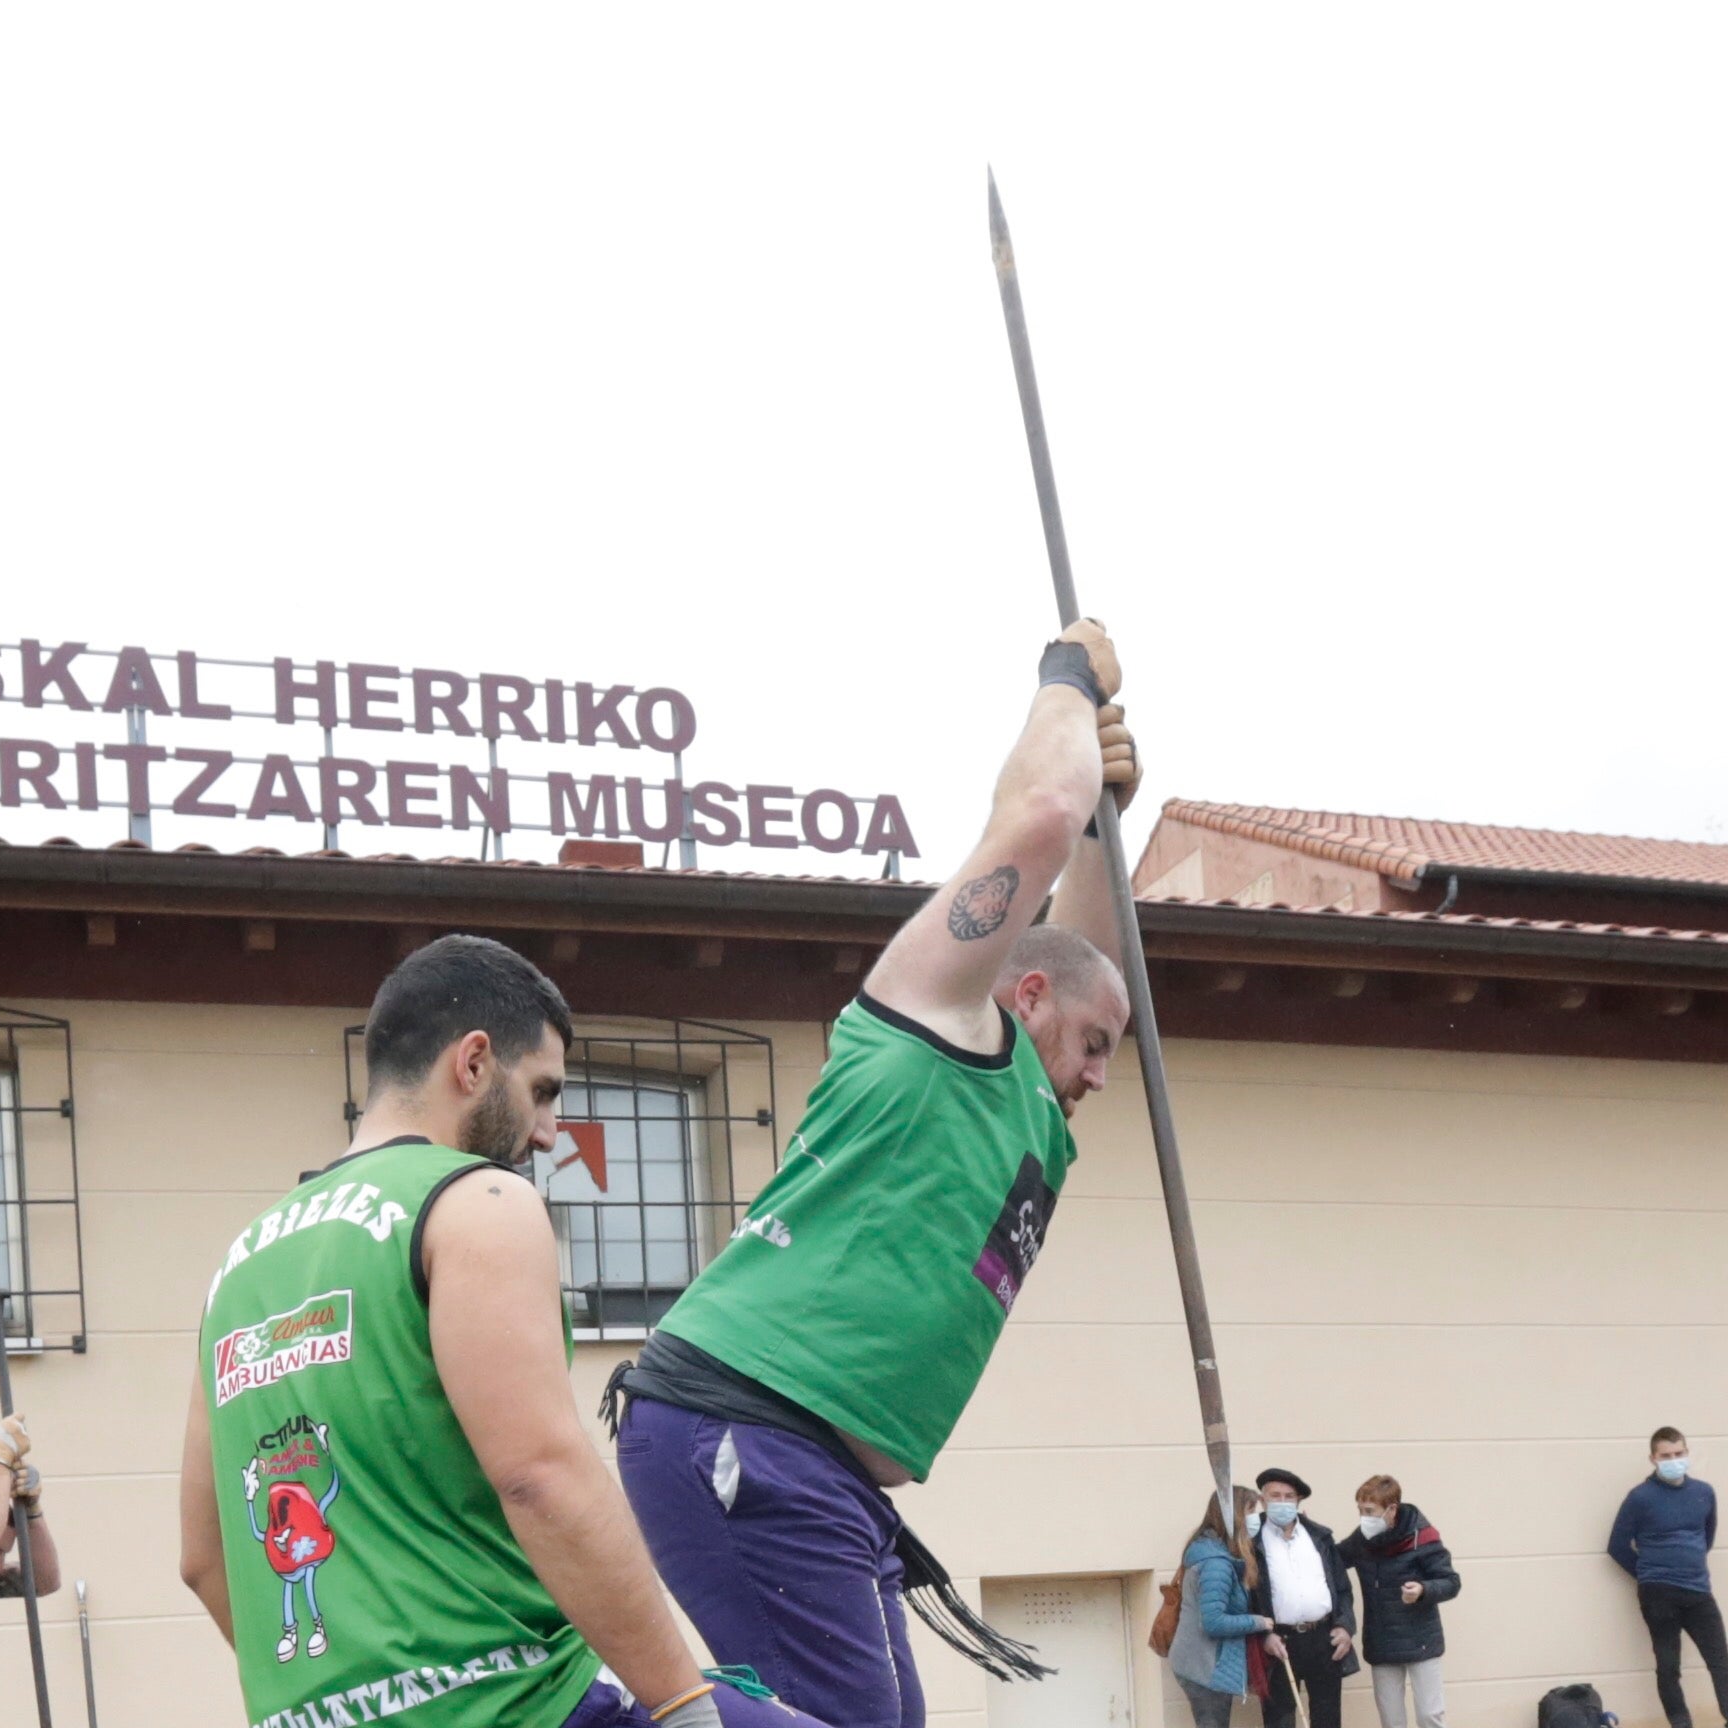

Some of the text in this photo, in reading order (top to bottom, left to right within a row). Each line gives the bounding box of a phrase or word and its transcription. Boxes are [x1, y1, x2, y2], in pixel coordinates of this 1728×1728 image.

[274, 657, 696, 753] HERRIKO
[547, 771, 921, 858] MUSEOA
[219, 1335, 348, 1404] AMBULANCIAS
